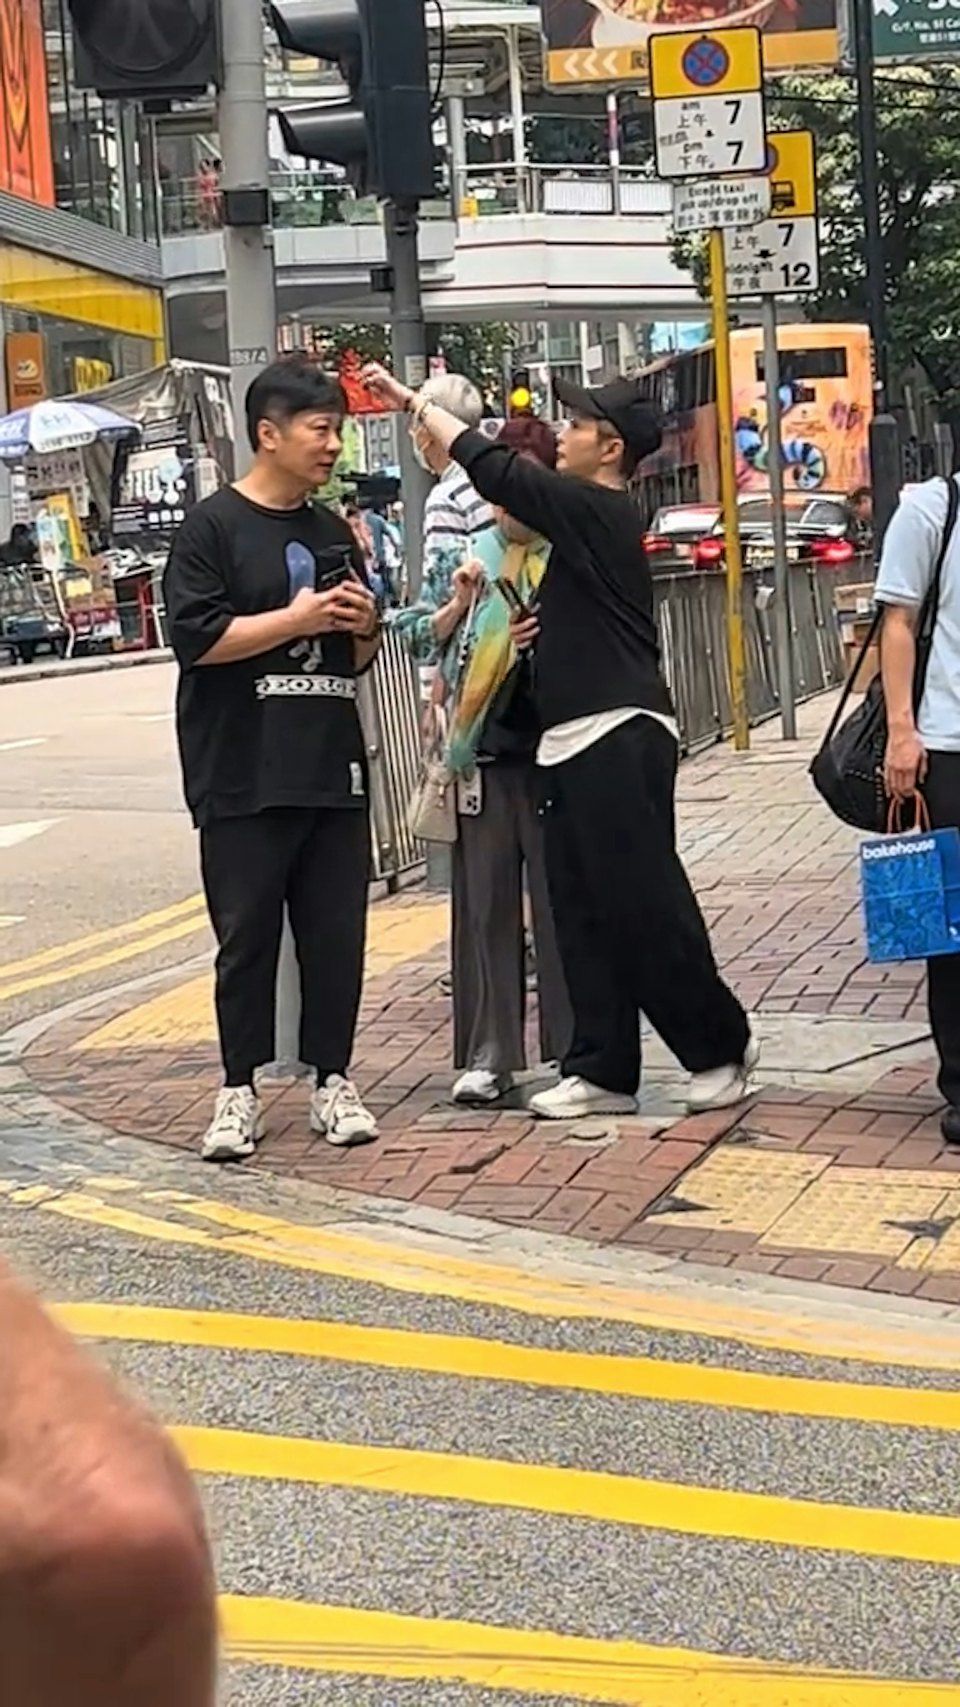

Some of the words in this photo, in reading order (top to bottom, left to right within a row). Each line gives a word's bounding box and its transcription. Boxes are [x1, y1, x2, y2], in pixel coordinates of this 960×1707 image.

[682, 102, 700, 110] am
[724, 100, 741, 125] 7
[678, 113, 707, 128] 上午
[683, 142, 703, 153] pm
[726, 141, 743, 165] 7
[679, 155, 709, 169] 下午
[723, 183, 745, 193] taxi
[778, 224, 794, 246] 7
[732, 236, 759, 250] 上午
[779, 262, 810, 287] 12
[863, 839, 936, 859] bakehouse
